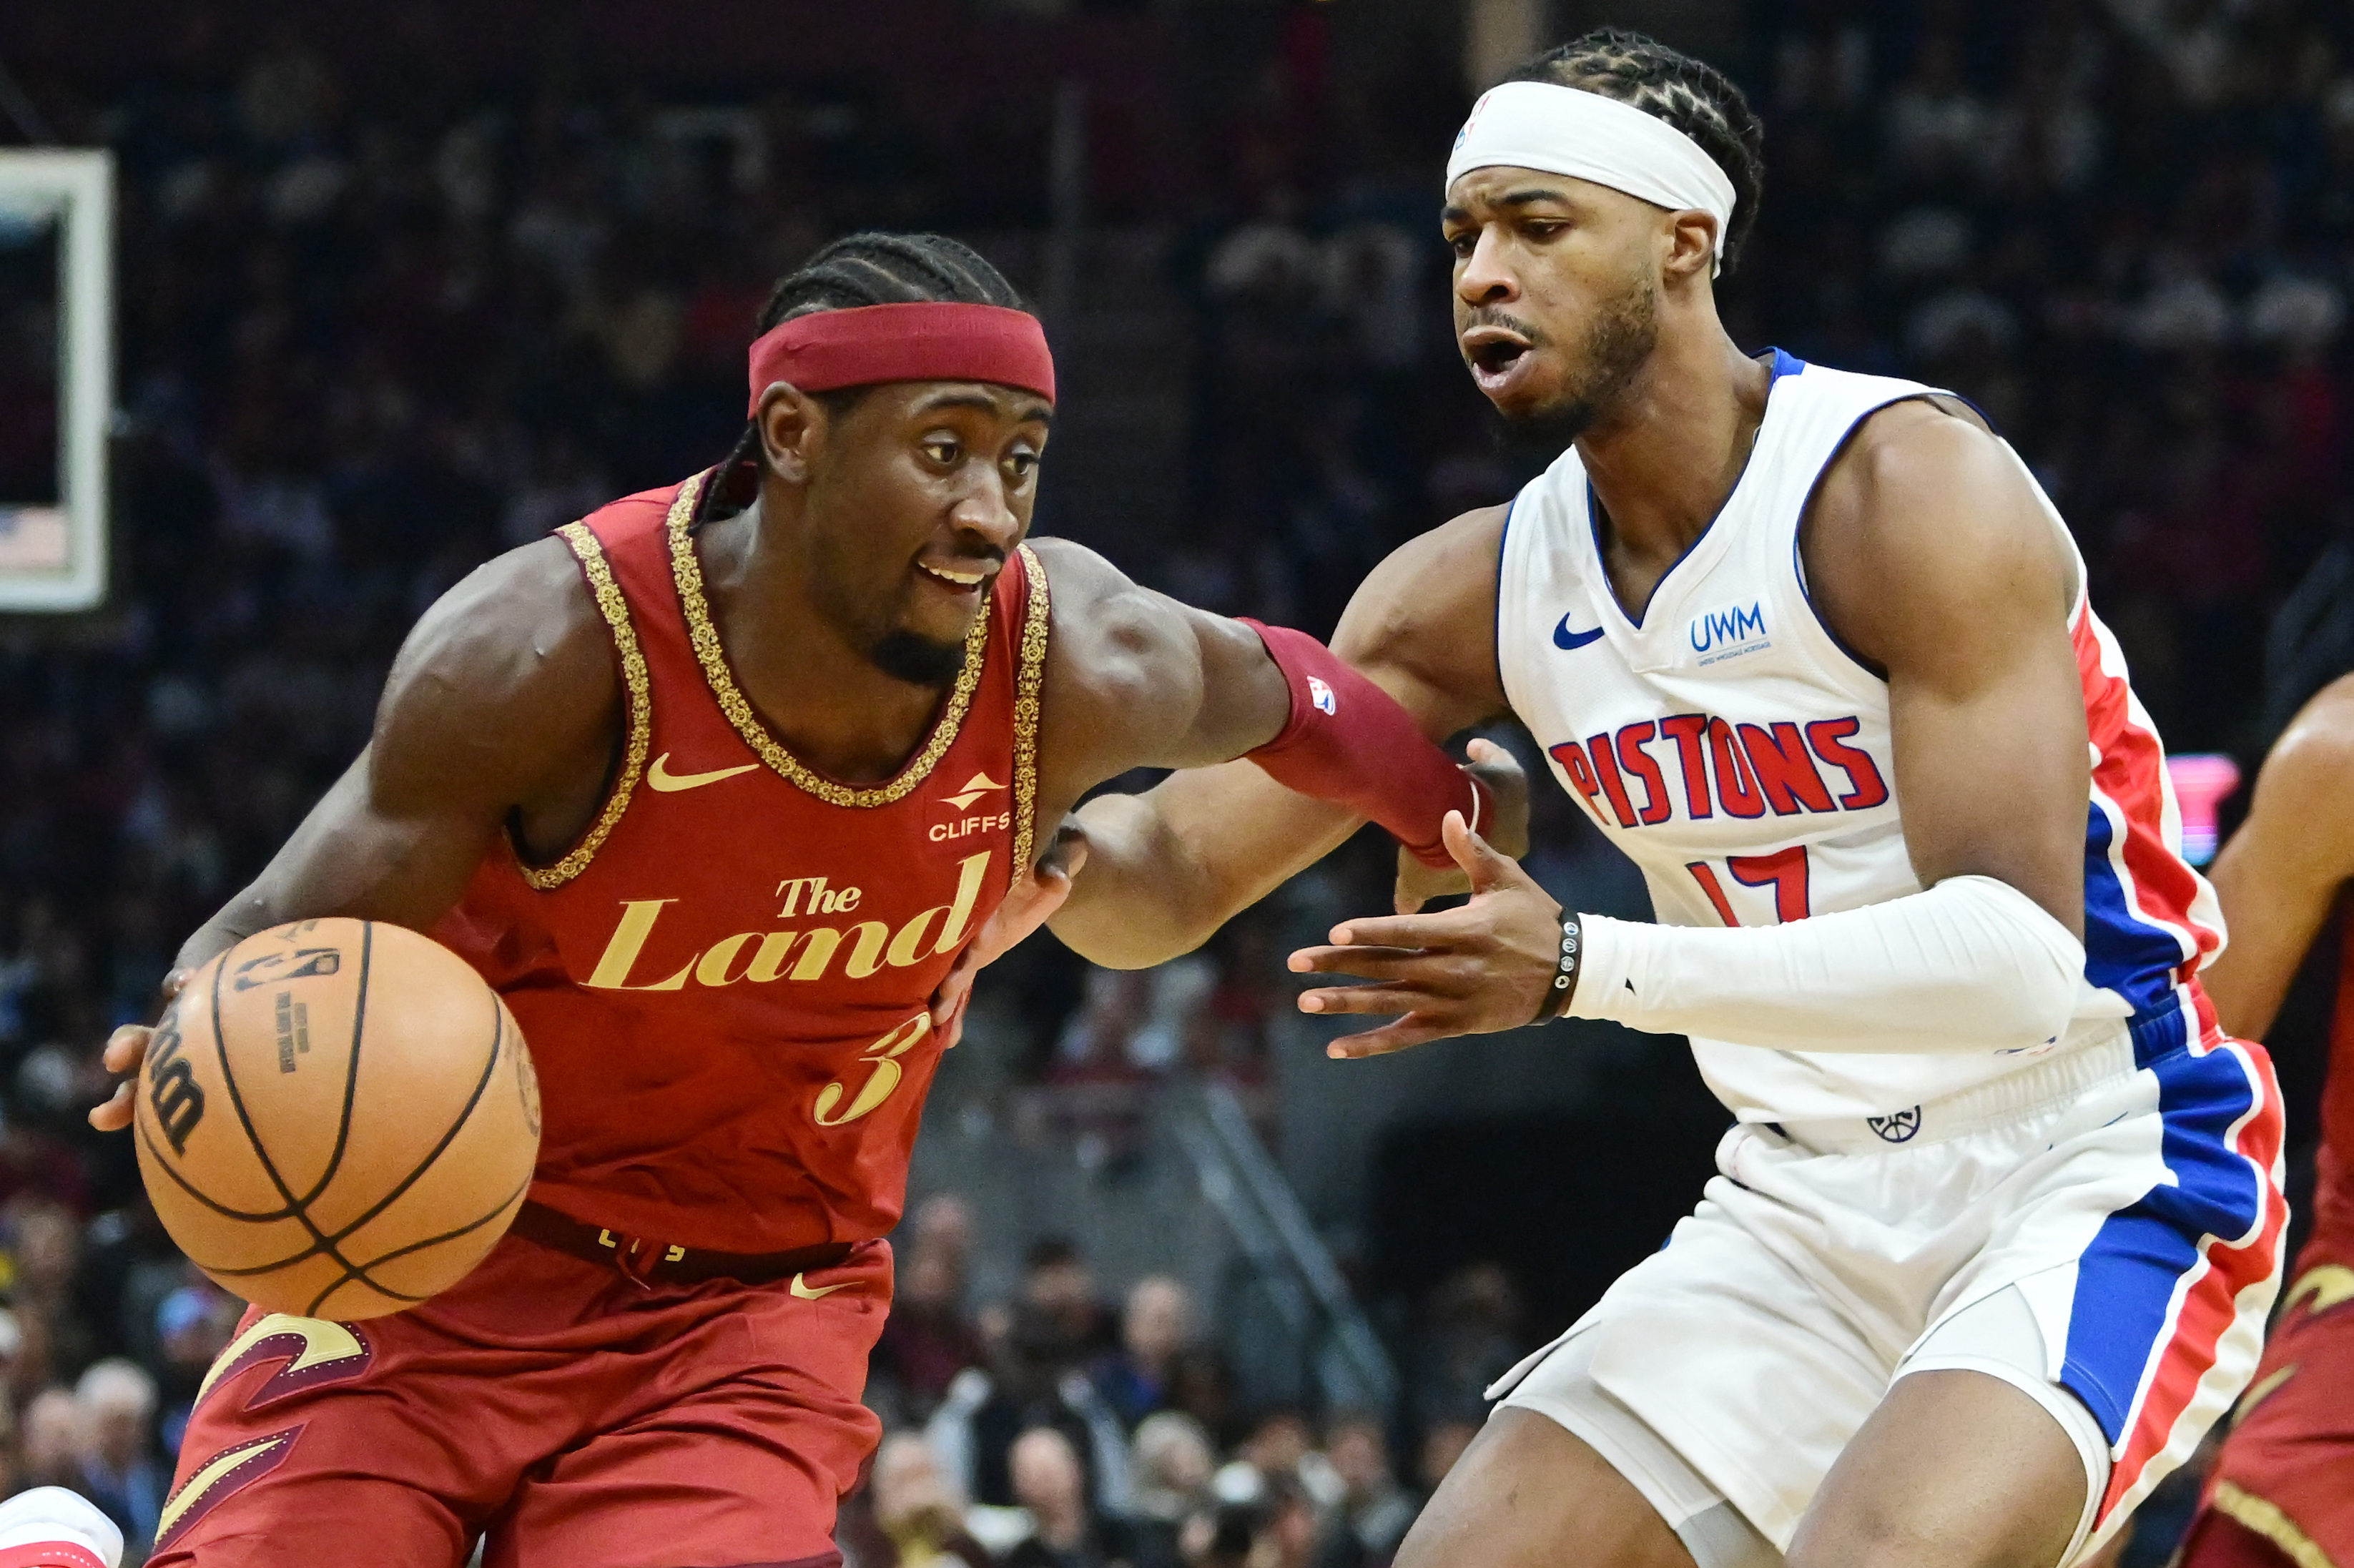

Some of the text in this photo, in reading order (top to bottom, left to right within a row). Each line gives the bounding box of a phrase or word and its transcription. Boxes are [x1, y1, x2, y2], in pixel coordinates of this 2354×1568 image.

[1690, 599, 1767, 652] UWM
[1549, 713, 1890, 828] PISTONS
[929, 811, 1011, 842] CLIFFS
[578, 850, 992, 991] Land
[775, 877, 862, 919] The
[1685, 844, 1810, 928] 17
[813, 1010, 932, 1127] 3
